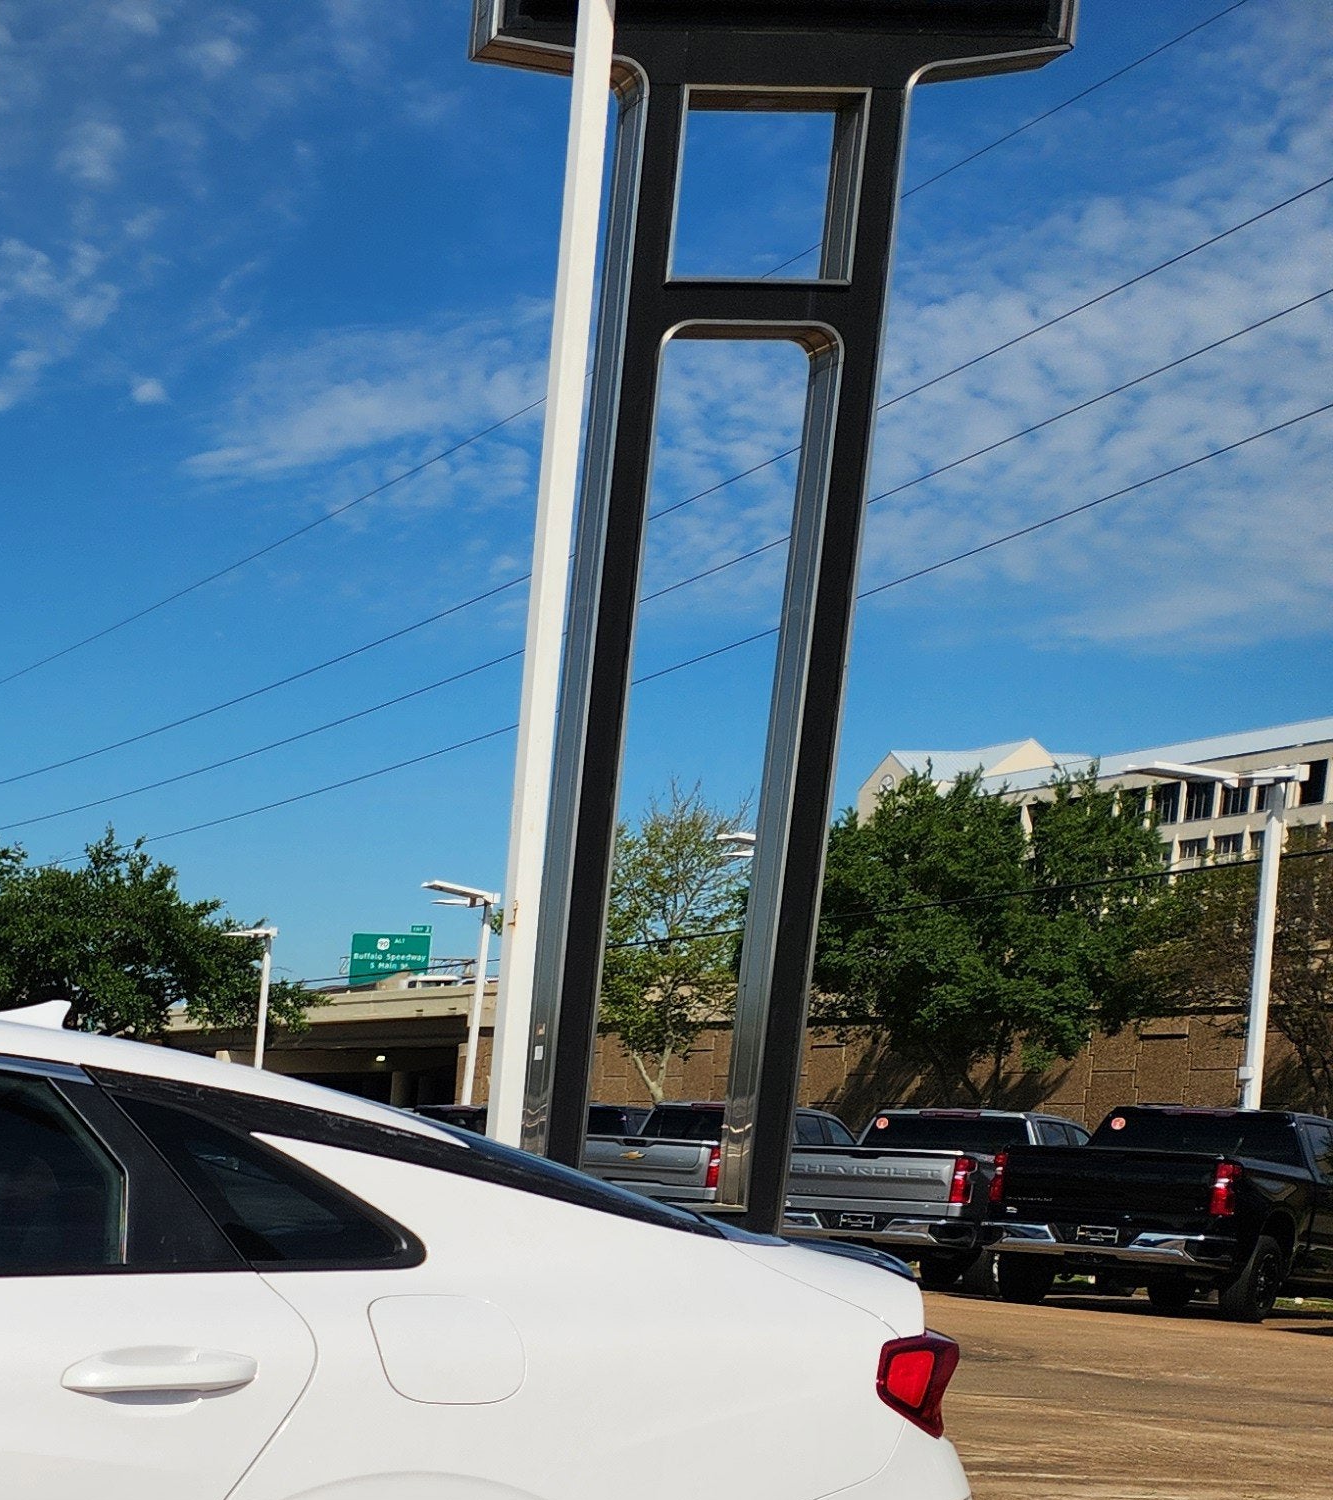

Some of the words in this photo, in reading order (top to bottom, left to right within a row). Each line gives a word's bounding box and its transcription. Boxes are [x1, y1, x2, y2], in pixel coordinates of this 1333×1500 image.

[379, 940, 389, 948] 90
[386, 953, 427, 962] Speedway
[790, 1163, 942, 1180] CHEVROLET
